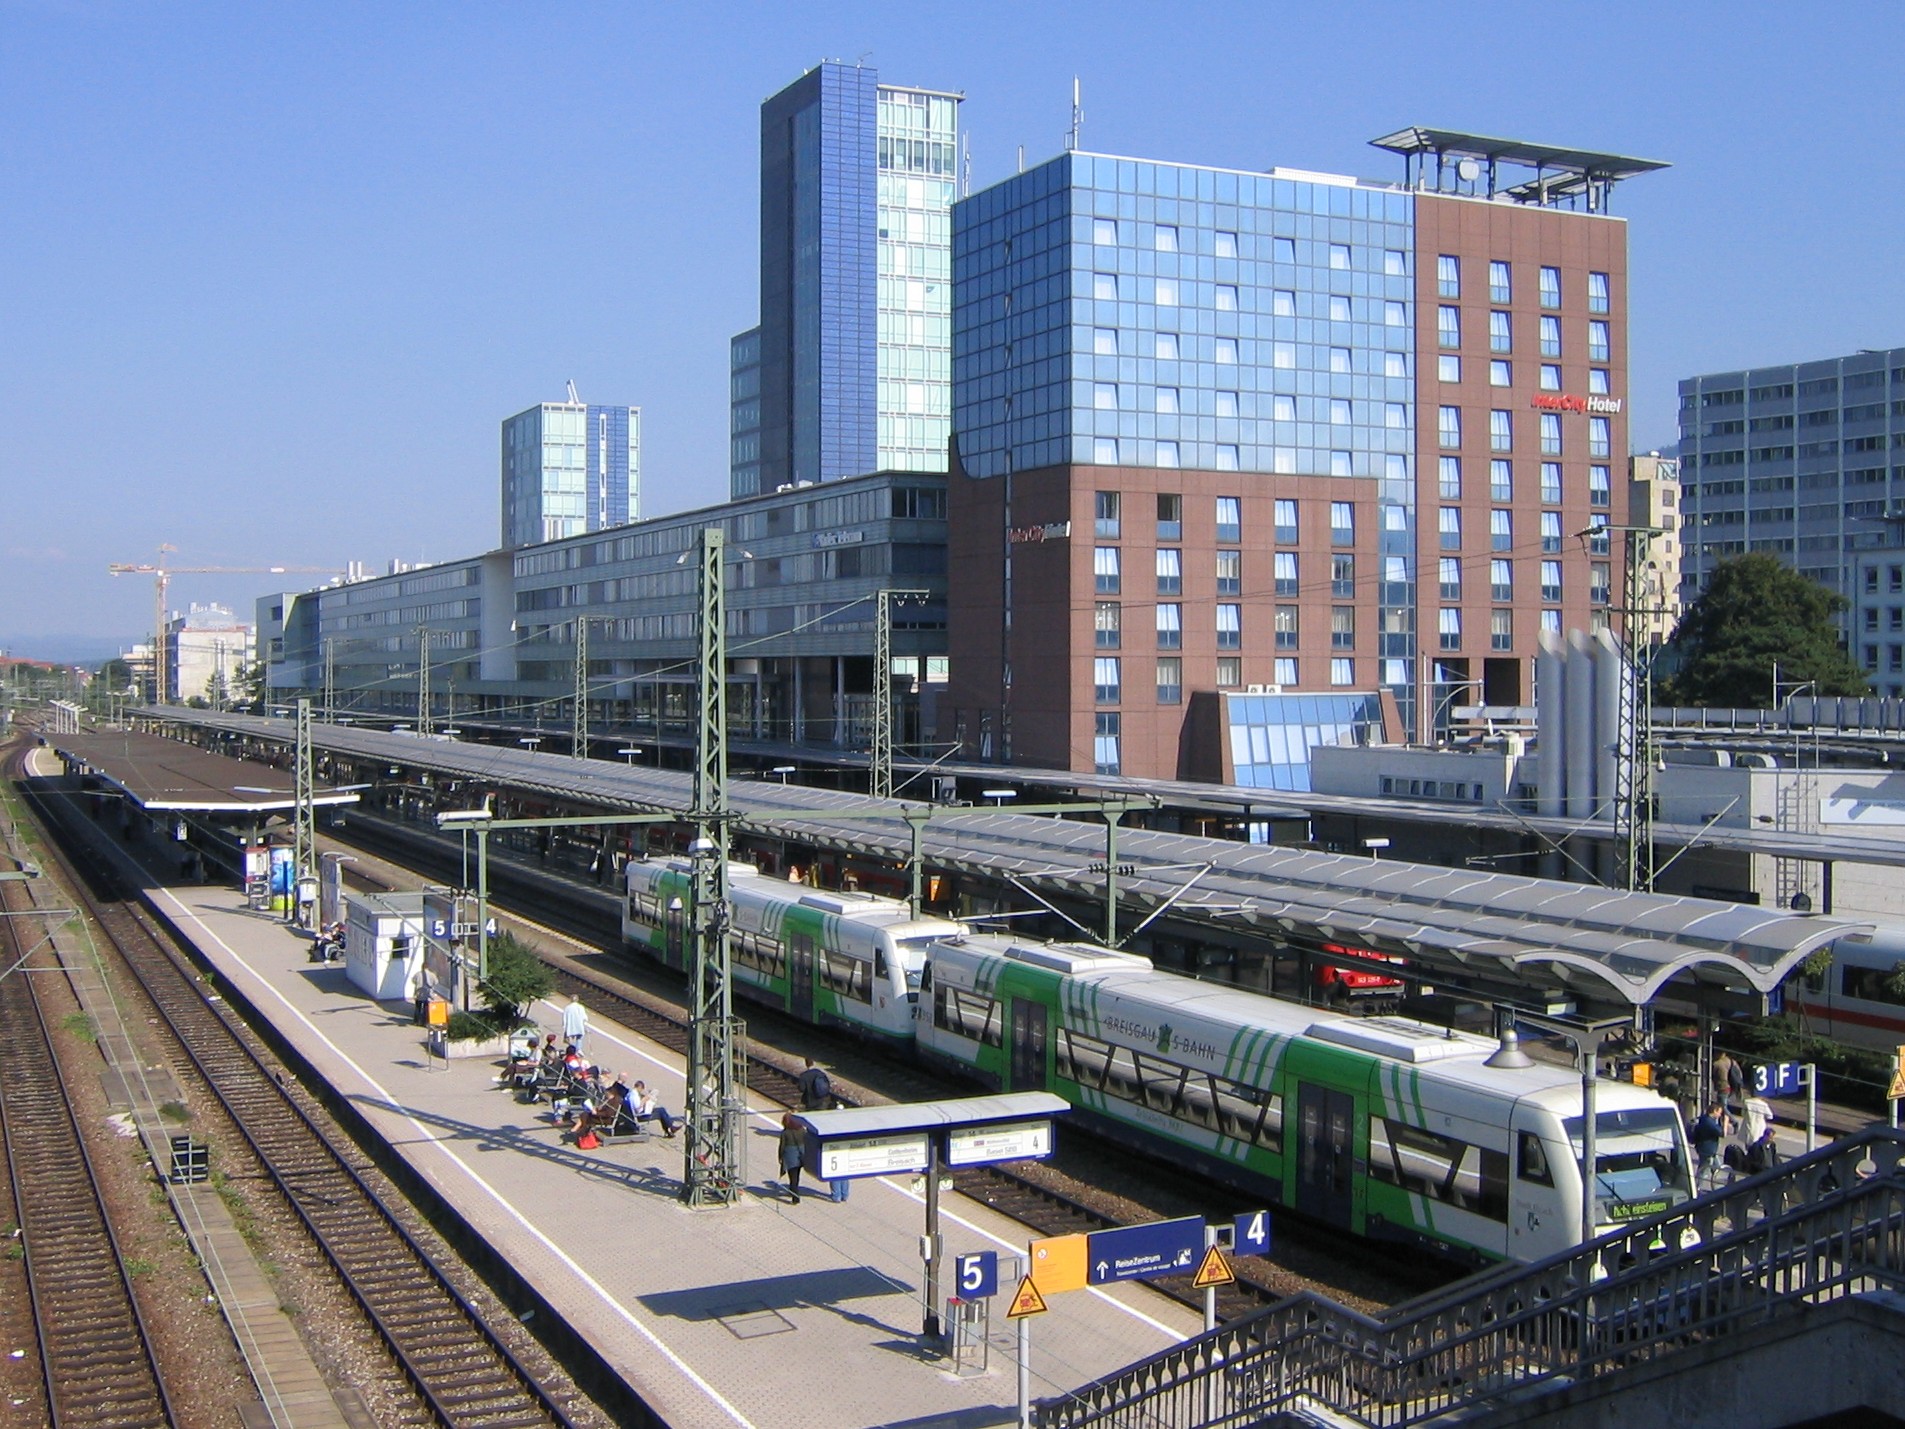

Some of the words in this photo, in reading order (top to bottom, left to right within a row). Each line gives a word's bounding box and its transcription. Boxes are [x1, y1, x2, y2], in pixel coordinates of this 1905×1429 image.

[434, 919, 446, 936] 5
[486, 918, 497, 934] 4
[1105, 1016, 1156, 1042] BREISGAU
[1755, 1065, 1768, 1092] 3
[1779, 1063, 1790, 1088] F
[1033, 1135, 1039, 1149] 4
[831, 1156, 838, 1172] 5
[1247, 1213, 1266, 1245] 4
[963, 1256, 983, 1290] 5
